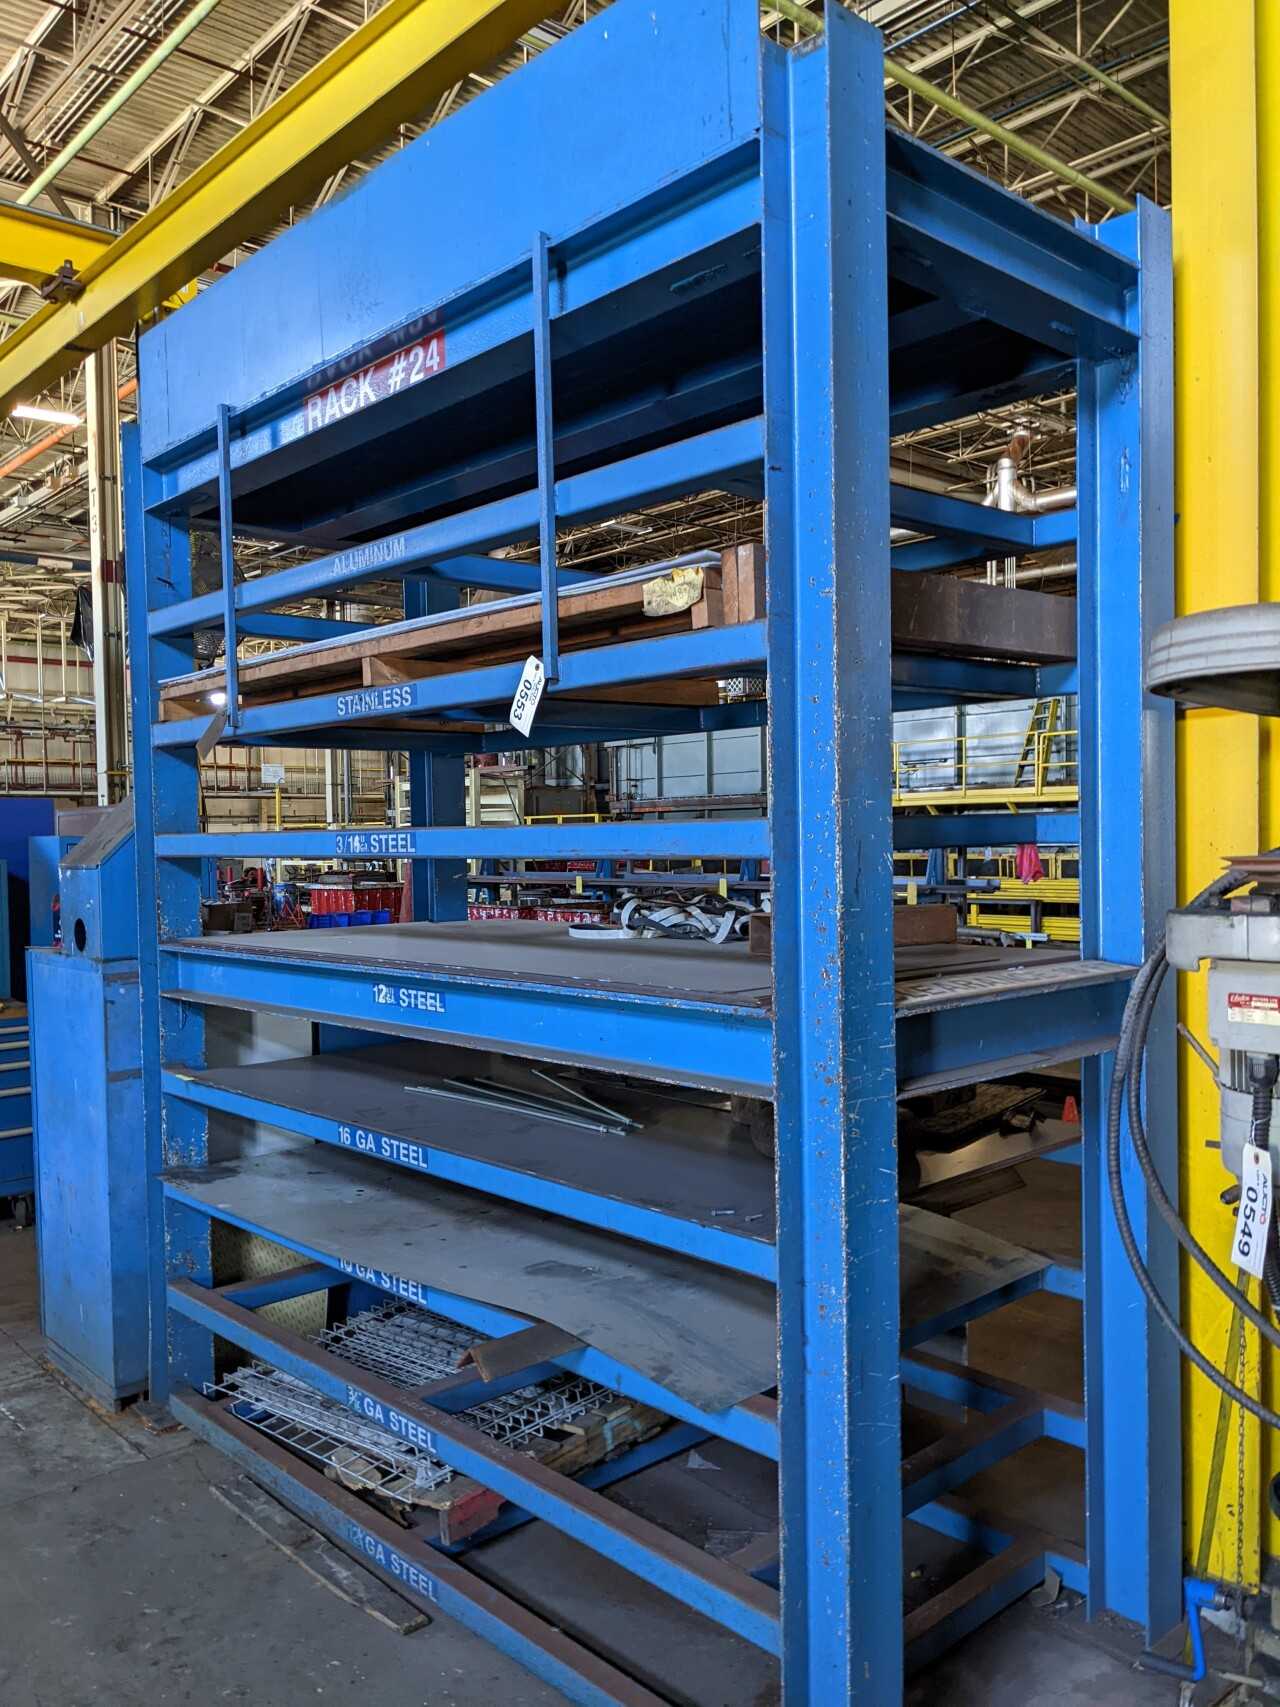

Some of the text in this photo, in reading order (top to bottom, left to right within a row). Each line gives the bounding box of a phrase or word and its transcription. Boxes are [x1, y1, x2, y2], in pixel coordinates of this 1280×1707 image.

[307, 338, 440, 432] RACK #24
[330, 536, 405, 576] ALUMINUM
[337, 686, 412, 716] STAINLESS
[513, 679, 532, 721] 0553
[370, 833, 415, 853] STEEL
[400, 988, 445, 1012] STEEL
[338, 1125, 427, 1168] 16 GA STEEL
[1238, 1186, 1258, 1257] 0549
[356, 1264, 376, 1283] GA
[381, 1272, 427, 1305] STEEL
[363, 1397, 385, 1424] GA
[389, 1411, 436, 1454] STEEL
[365, 1536, 386, 1565] GA
[390, 1554, 437, 1602] STEEL
